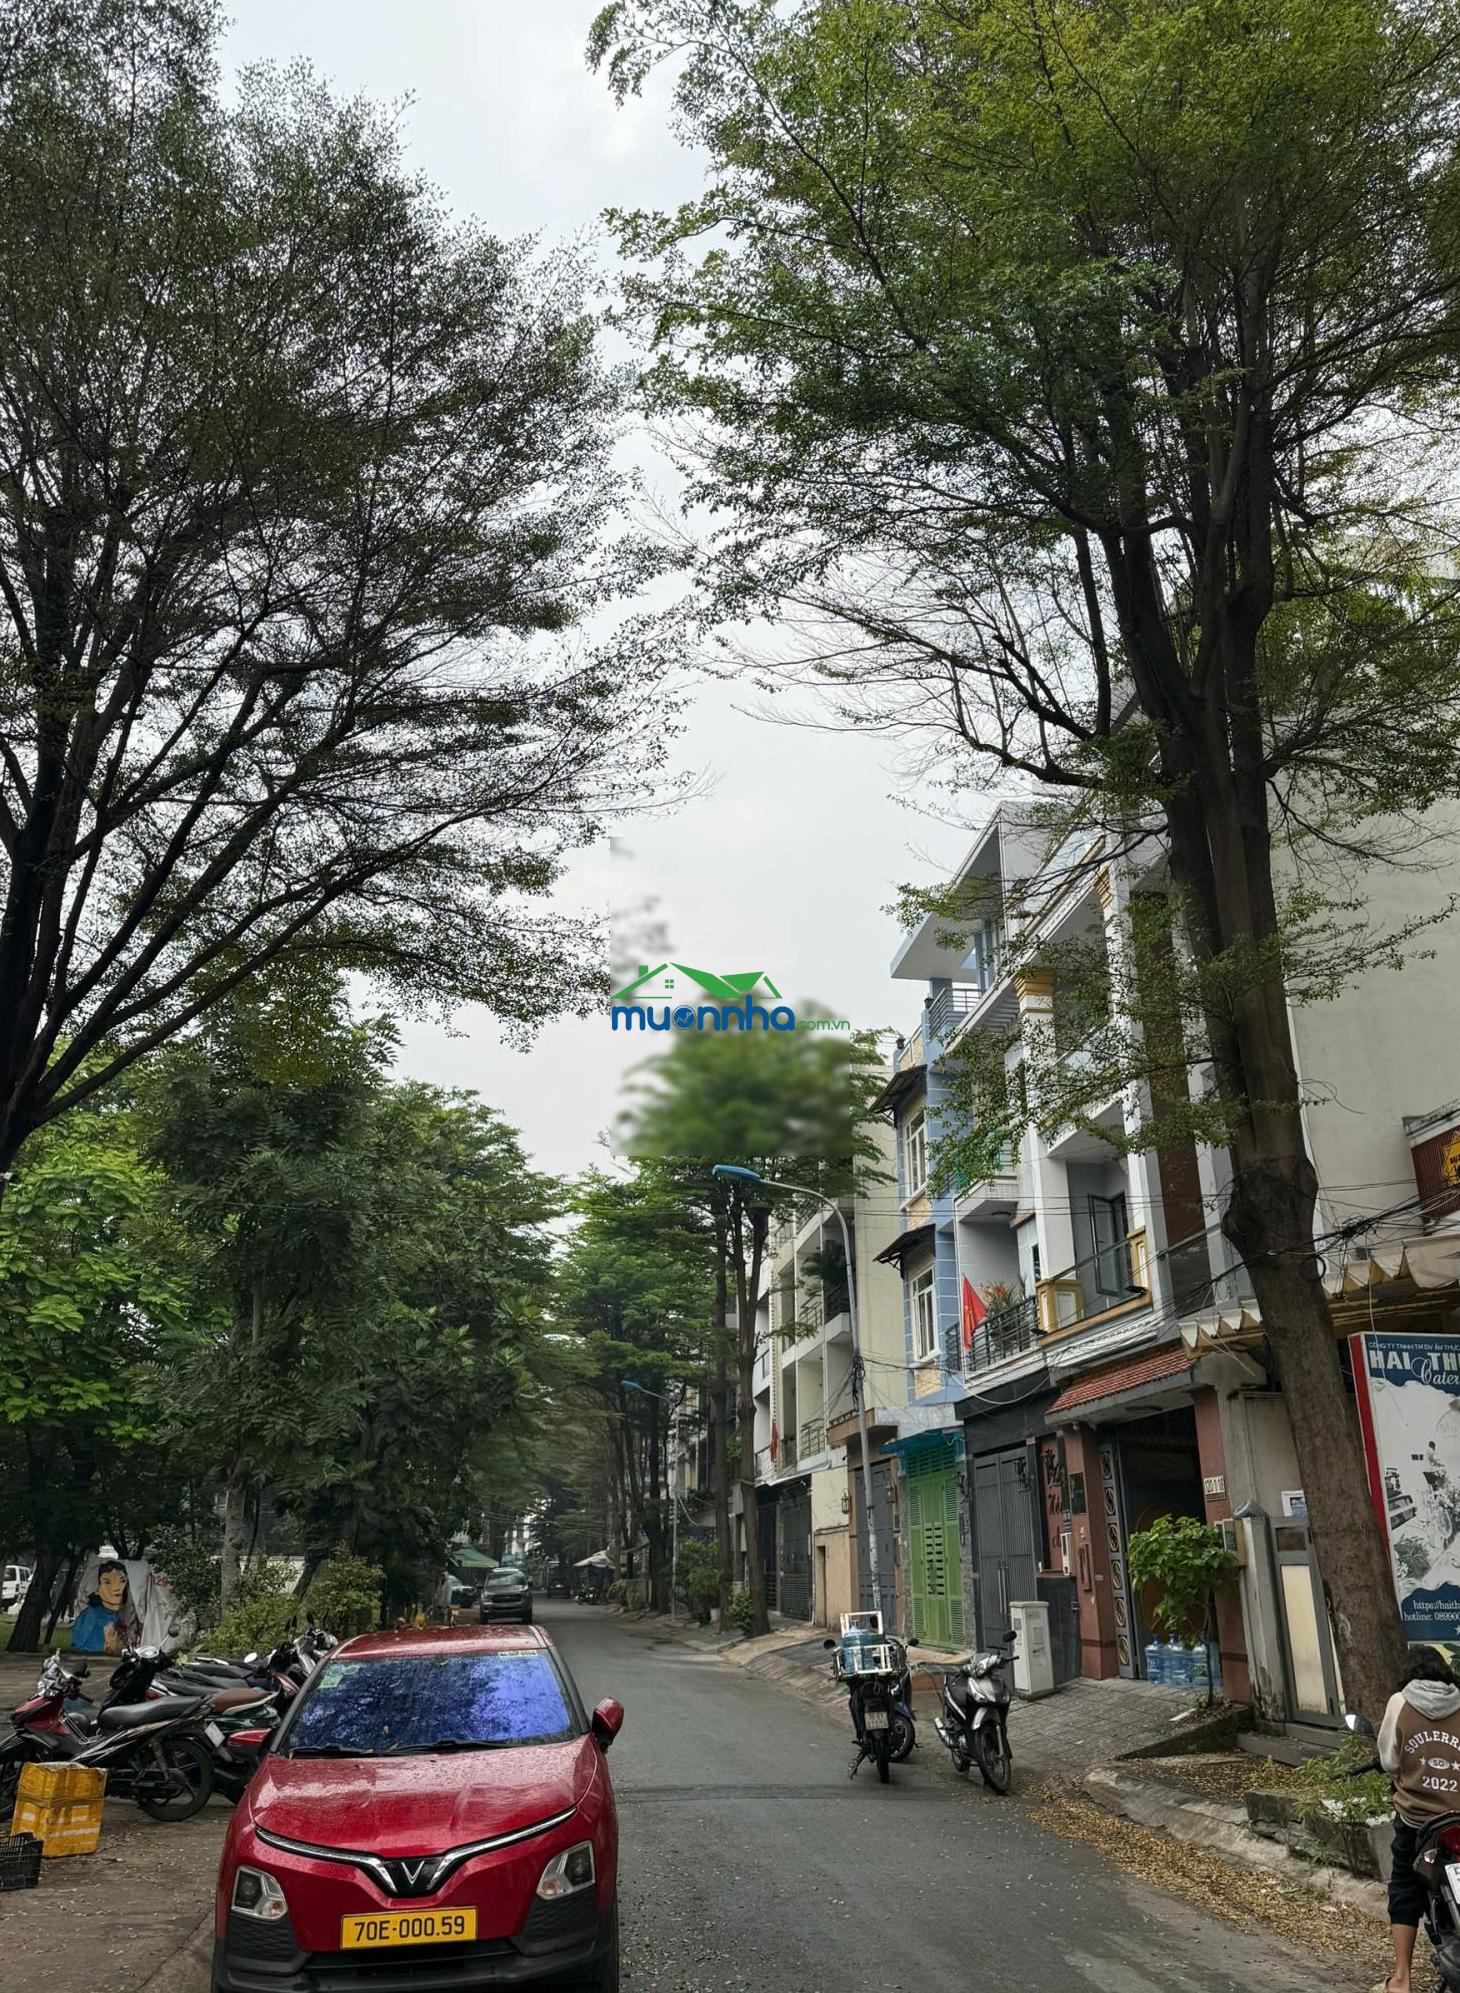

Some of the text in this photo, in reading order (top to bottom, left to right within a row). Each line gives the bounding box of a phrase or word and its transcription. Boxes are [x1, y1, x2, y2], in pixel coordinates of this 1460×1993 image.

[1404, 1730, 1460, 1754] SOULERR
[1422, 1775, 1459, 1792] 2022
[354, 1915, 465, 1942] 70E-000.59
